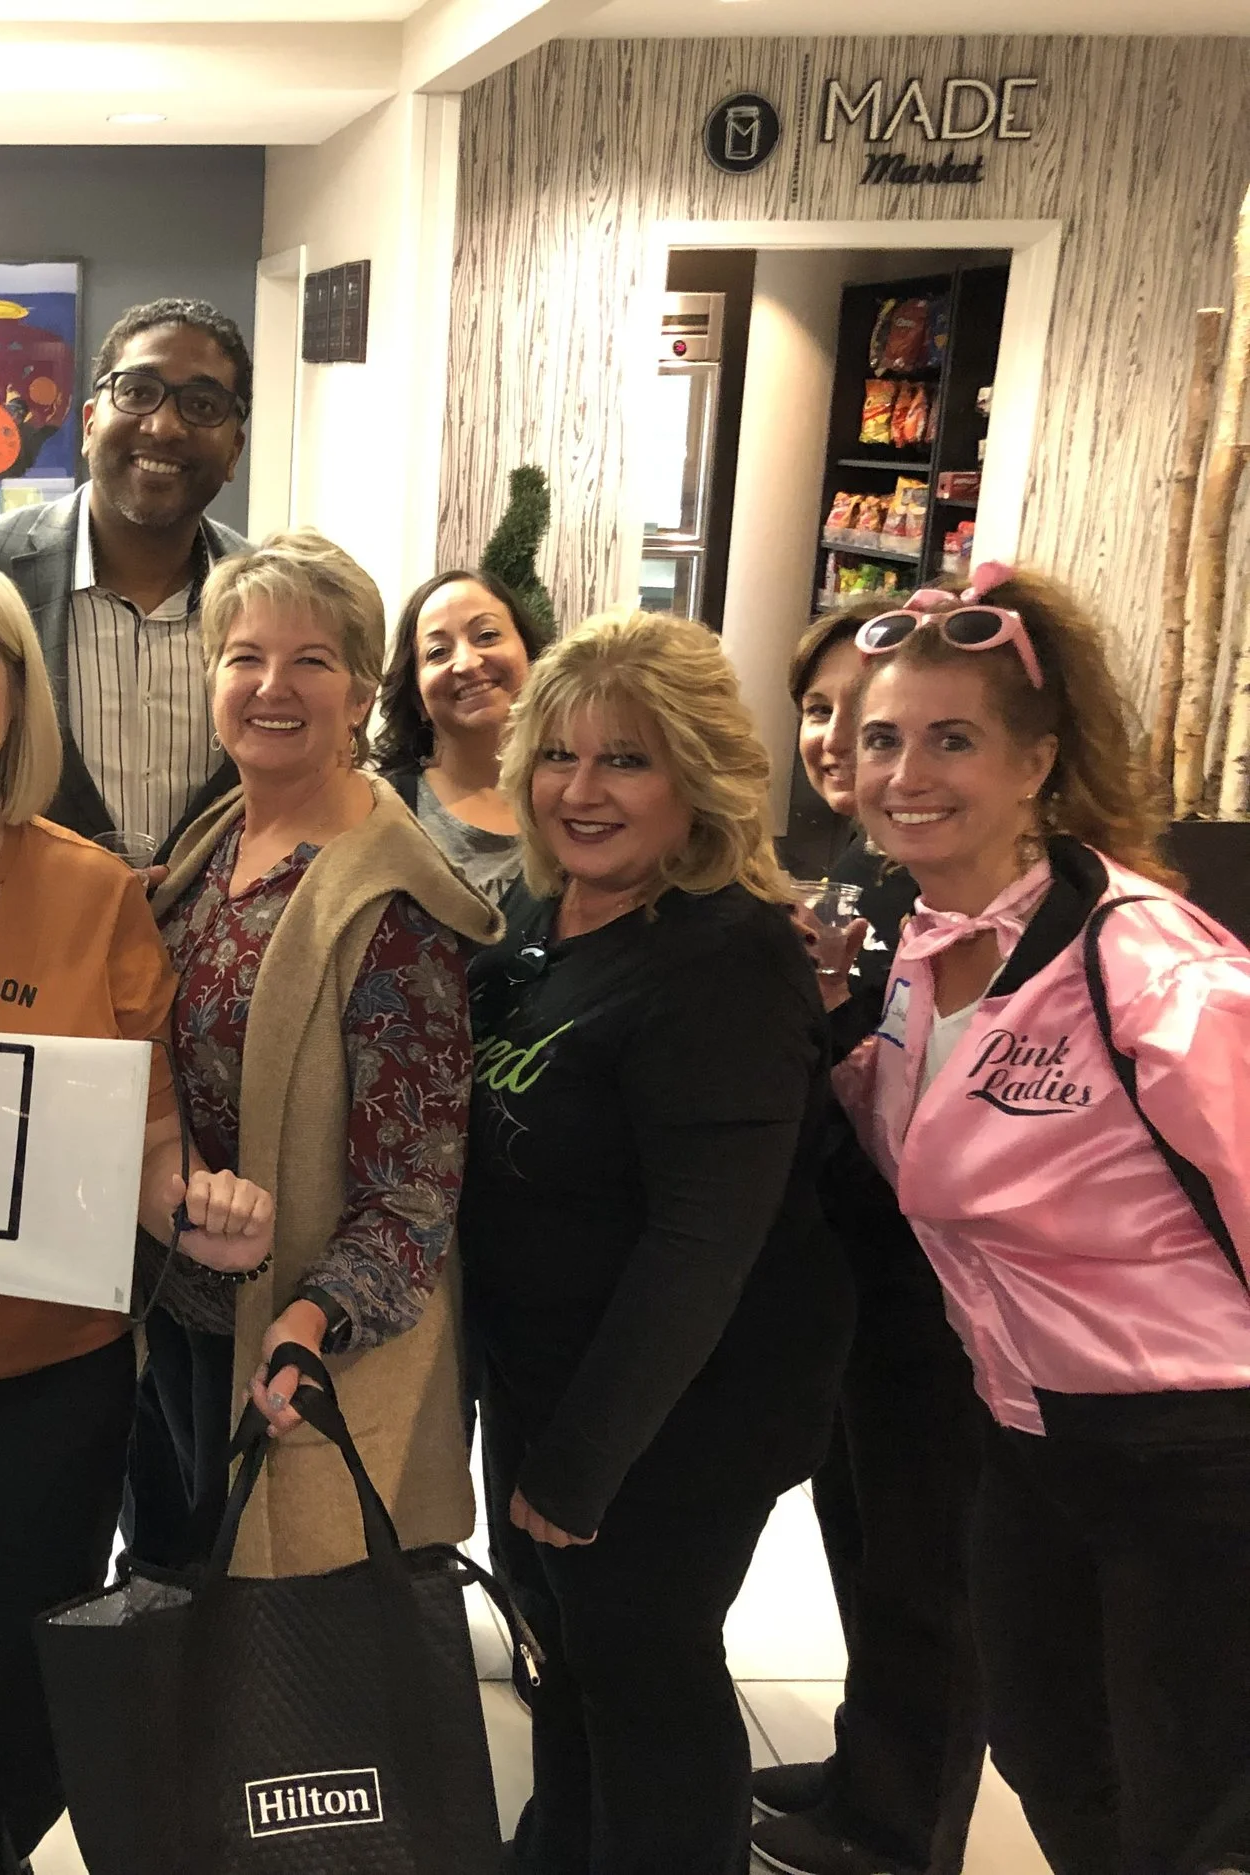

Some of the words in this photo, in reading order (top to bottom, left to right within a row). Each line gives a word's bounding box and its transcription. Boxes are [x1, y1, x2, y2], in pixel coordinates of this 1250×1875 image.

[820, 78, 1040, 141] MADE
[859, 152, 986, 184] Market
[966, 1028, 1071, 1078] Pink
[965, 1067, 1093, 1116] Ladies
[257, 1786, 371, 1824] Hilton
